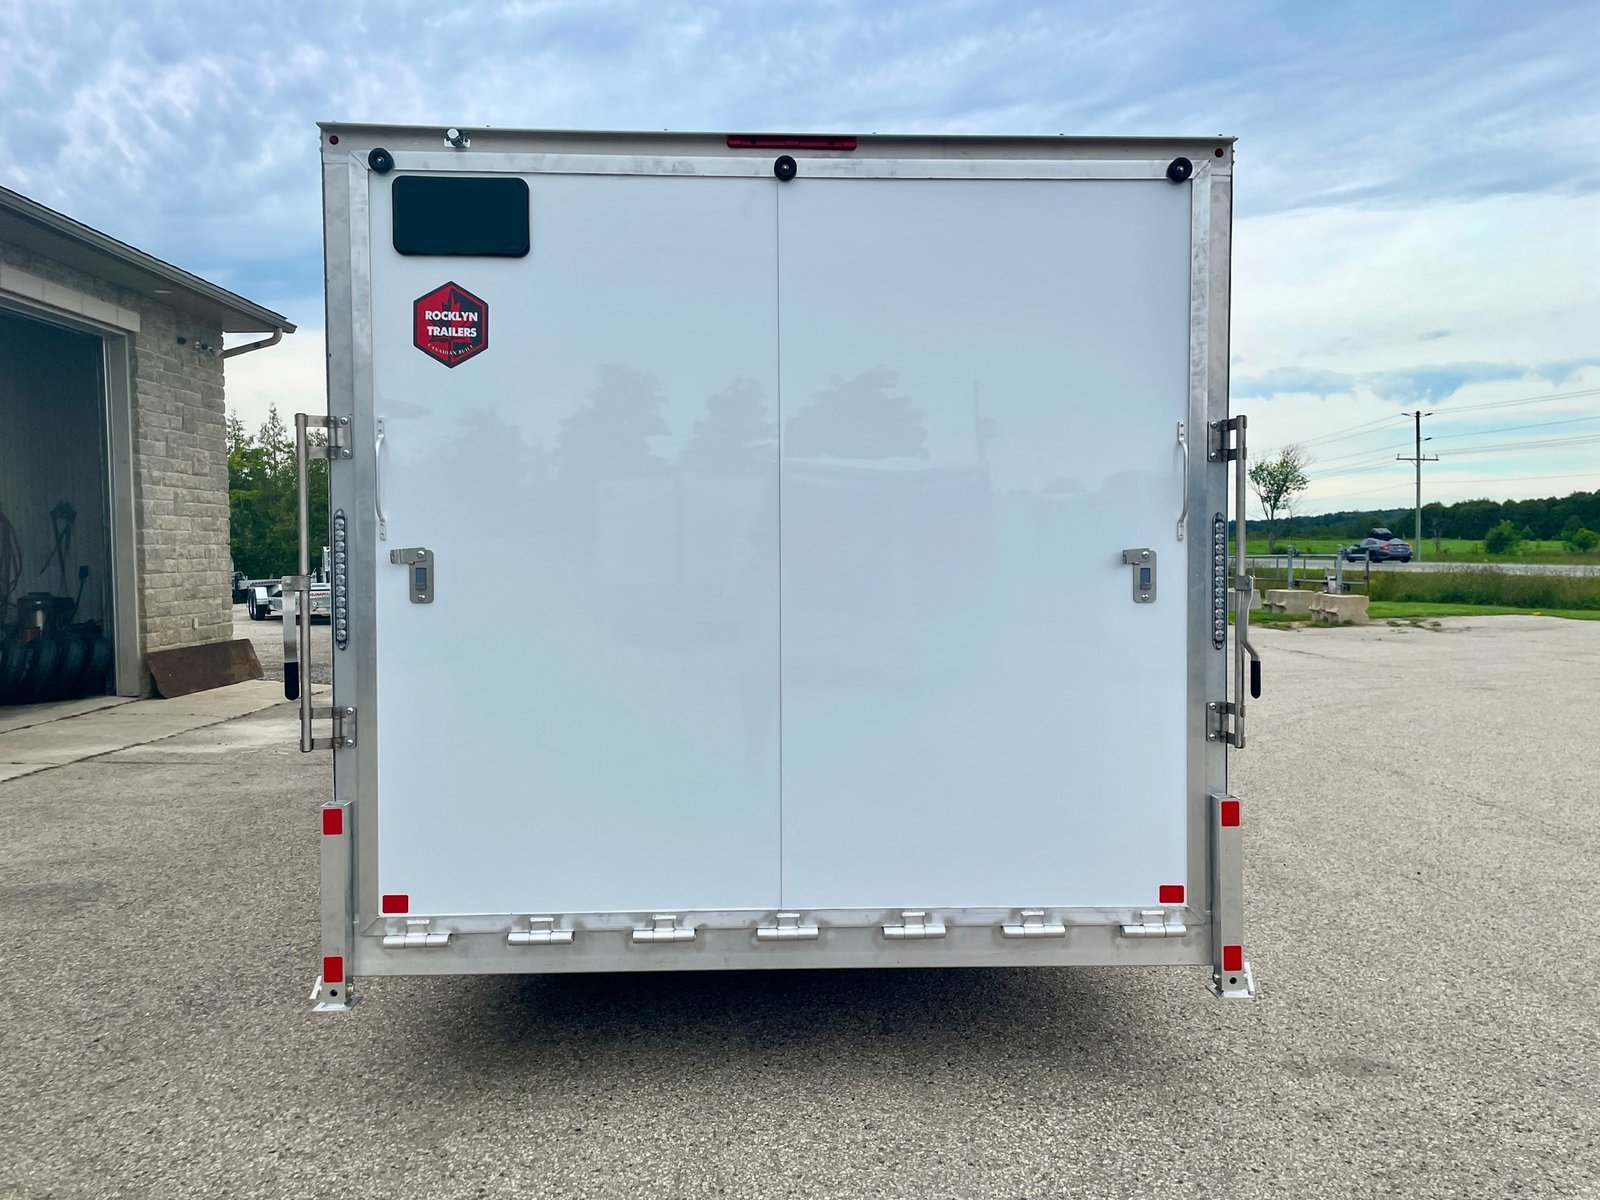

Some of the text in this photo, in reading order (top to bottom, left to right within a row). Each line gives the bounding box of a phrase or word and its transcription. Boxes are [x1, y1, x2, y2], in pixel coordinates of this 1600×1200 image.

[425, 310, 478, 322] ROCKLYN
[427, 326, 477, 337] TRAILERS
[427, 343, 457, 356] CANADIAN
